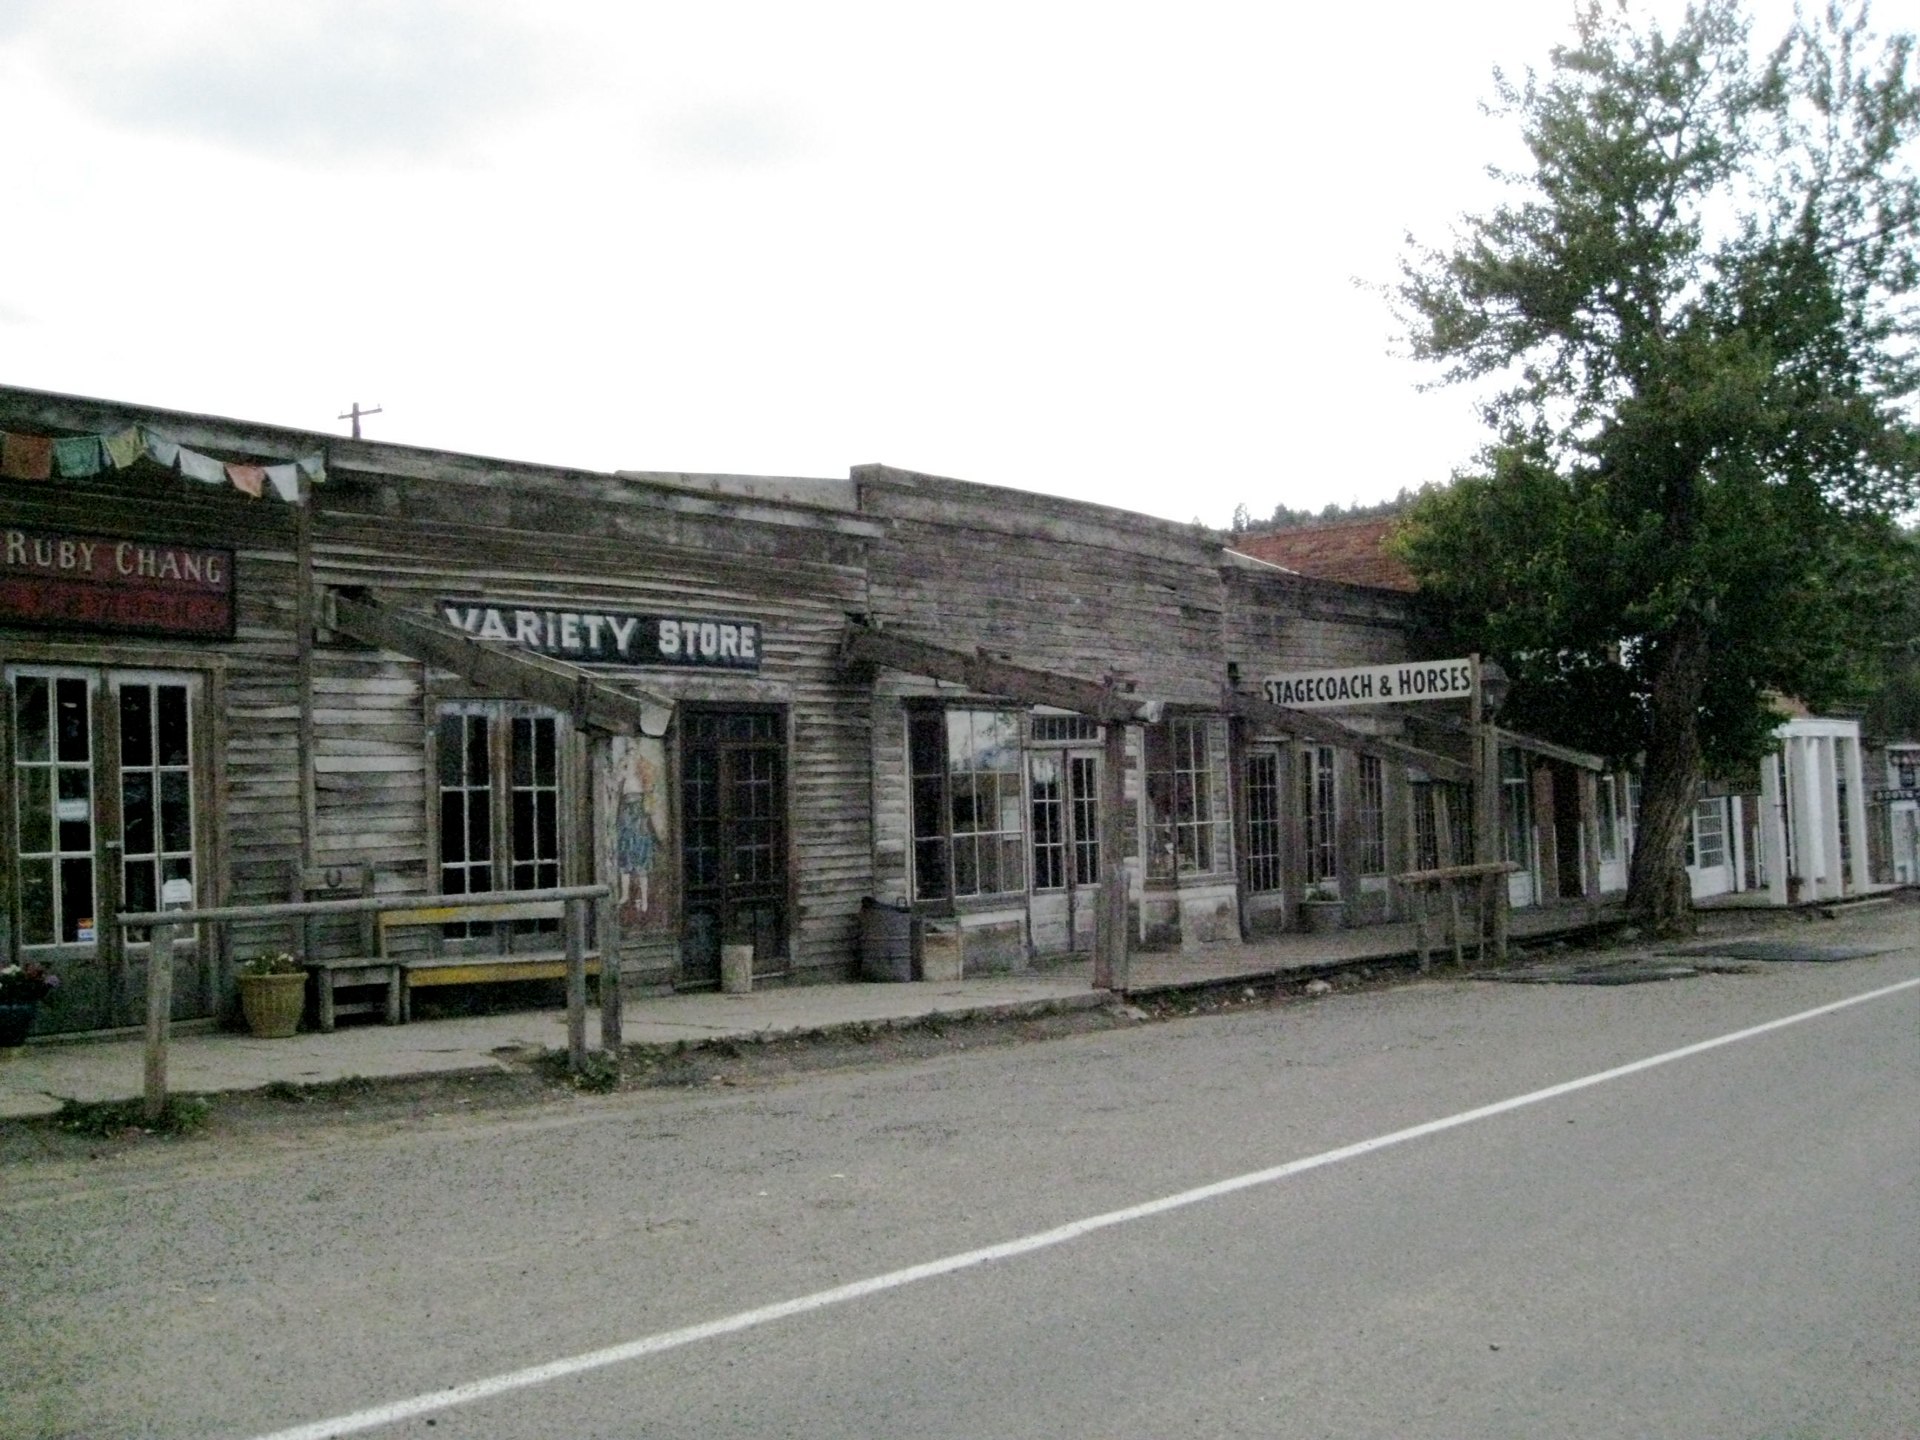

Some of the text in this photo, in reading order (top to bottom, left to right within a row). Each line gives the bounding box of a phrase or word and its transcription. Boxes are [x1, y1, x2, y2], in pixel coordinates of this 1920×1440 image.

[6, 530, 221, 584] RUBY CHANG
[445, 608, 755, 658] VARIETY STORE
[1264, 666, 1471, 704] STAGECOACH & HORSES
